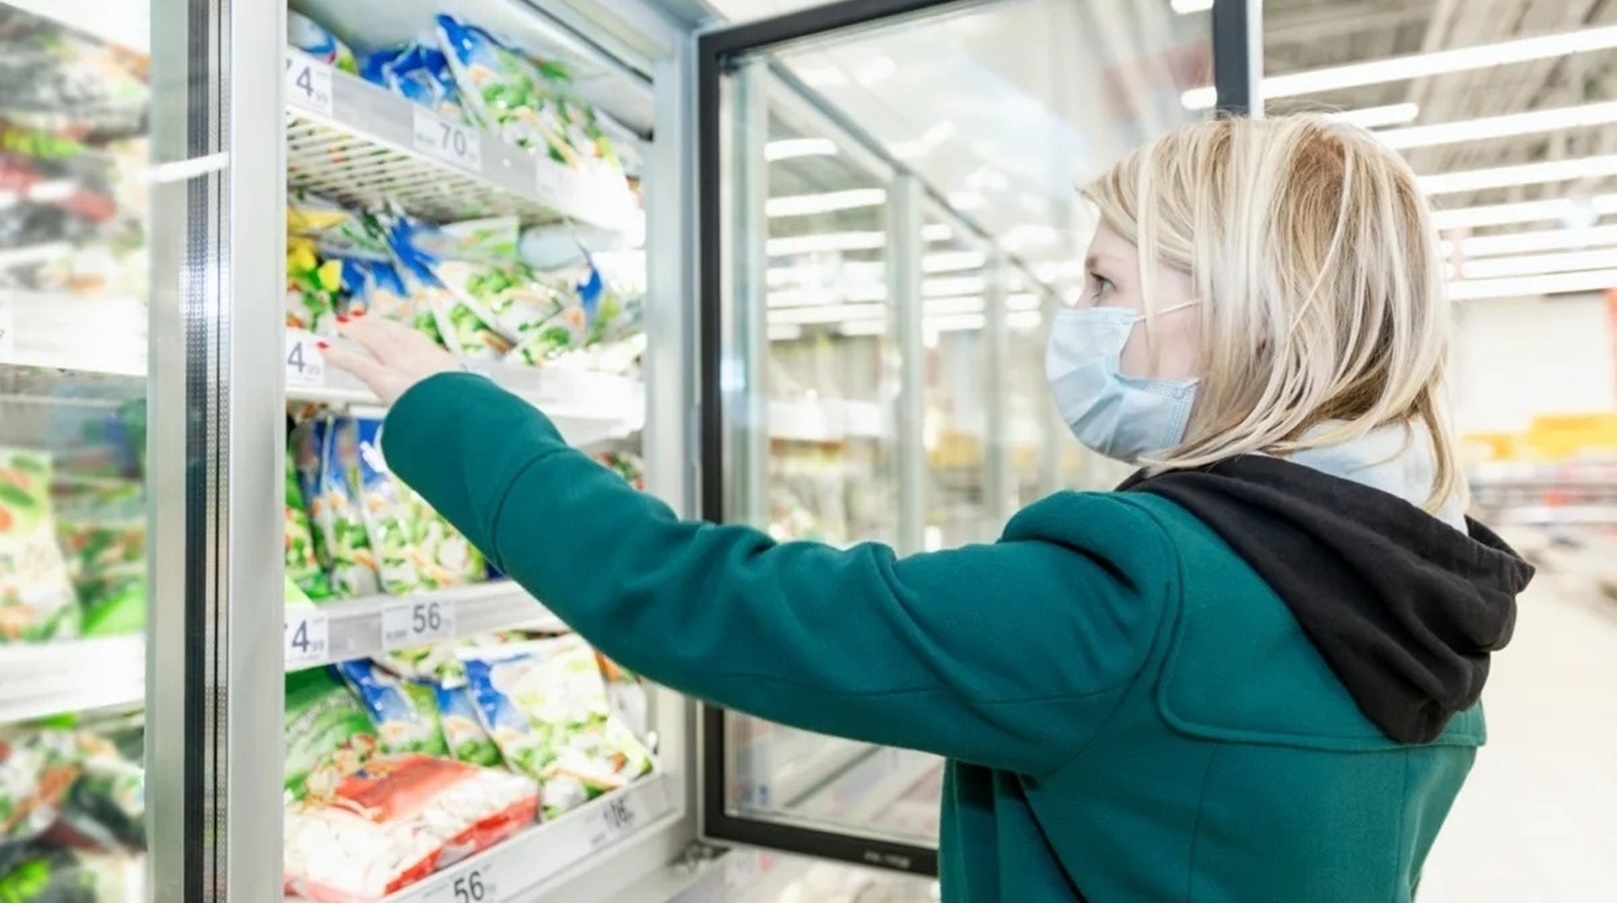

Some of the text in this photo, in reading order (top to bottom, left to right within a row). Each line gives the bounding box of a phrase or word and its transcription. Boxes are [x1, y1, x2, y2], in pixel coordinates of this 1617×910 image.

[439, 121, 466, 157] 70
[413, 601, 442, 634] 56
[454, 871, 485, 903] 56
